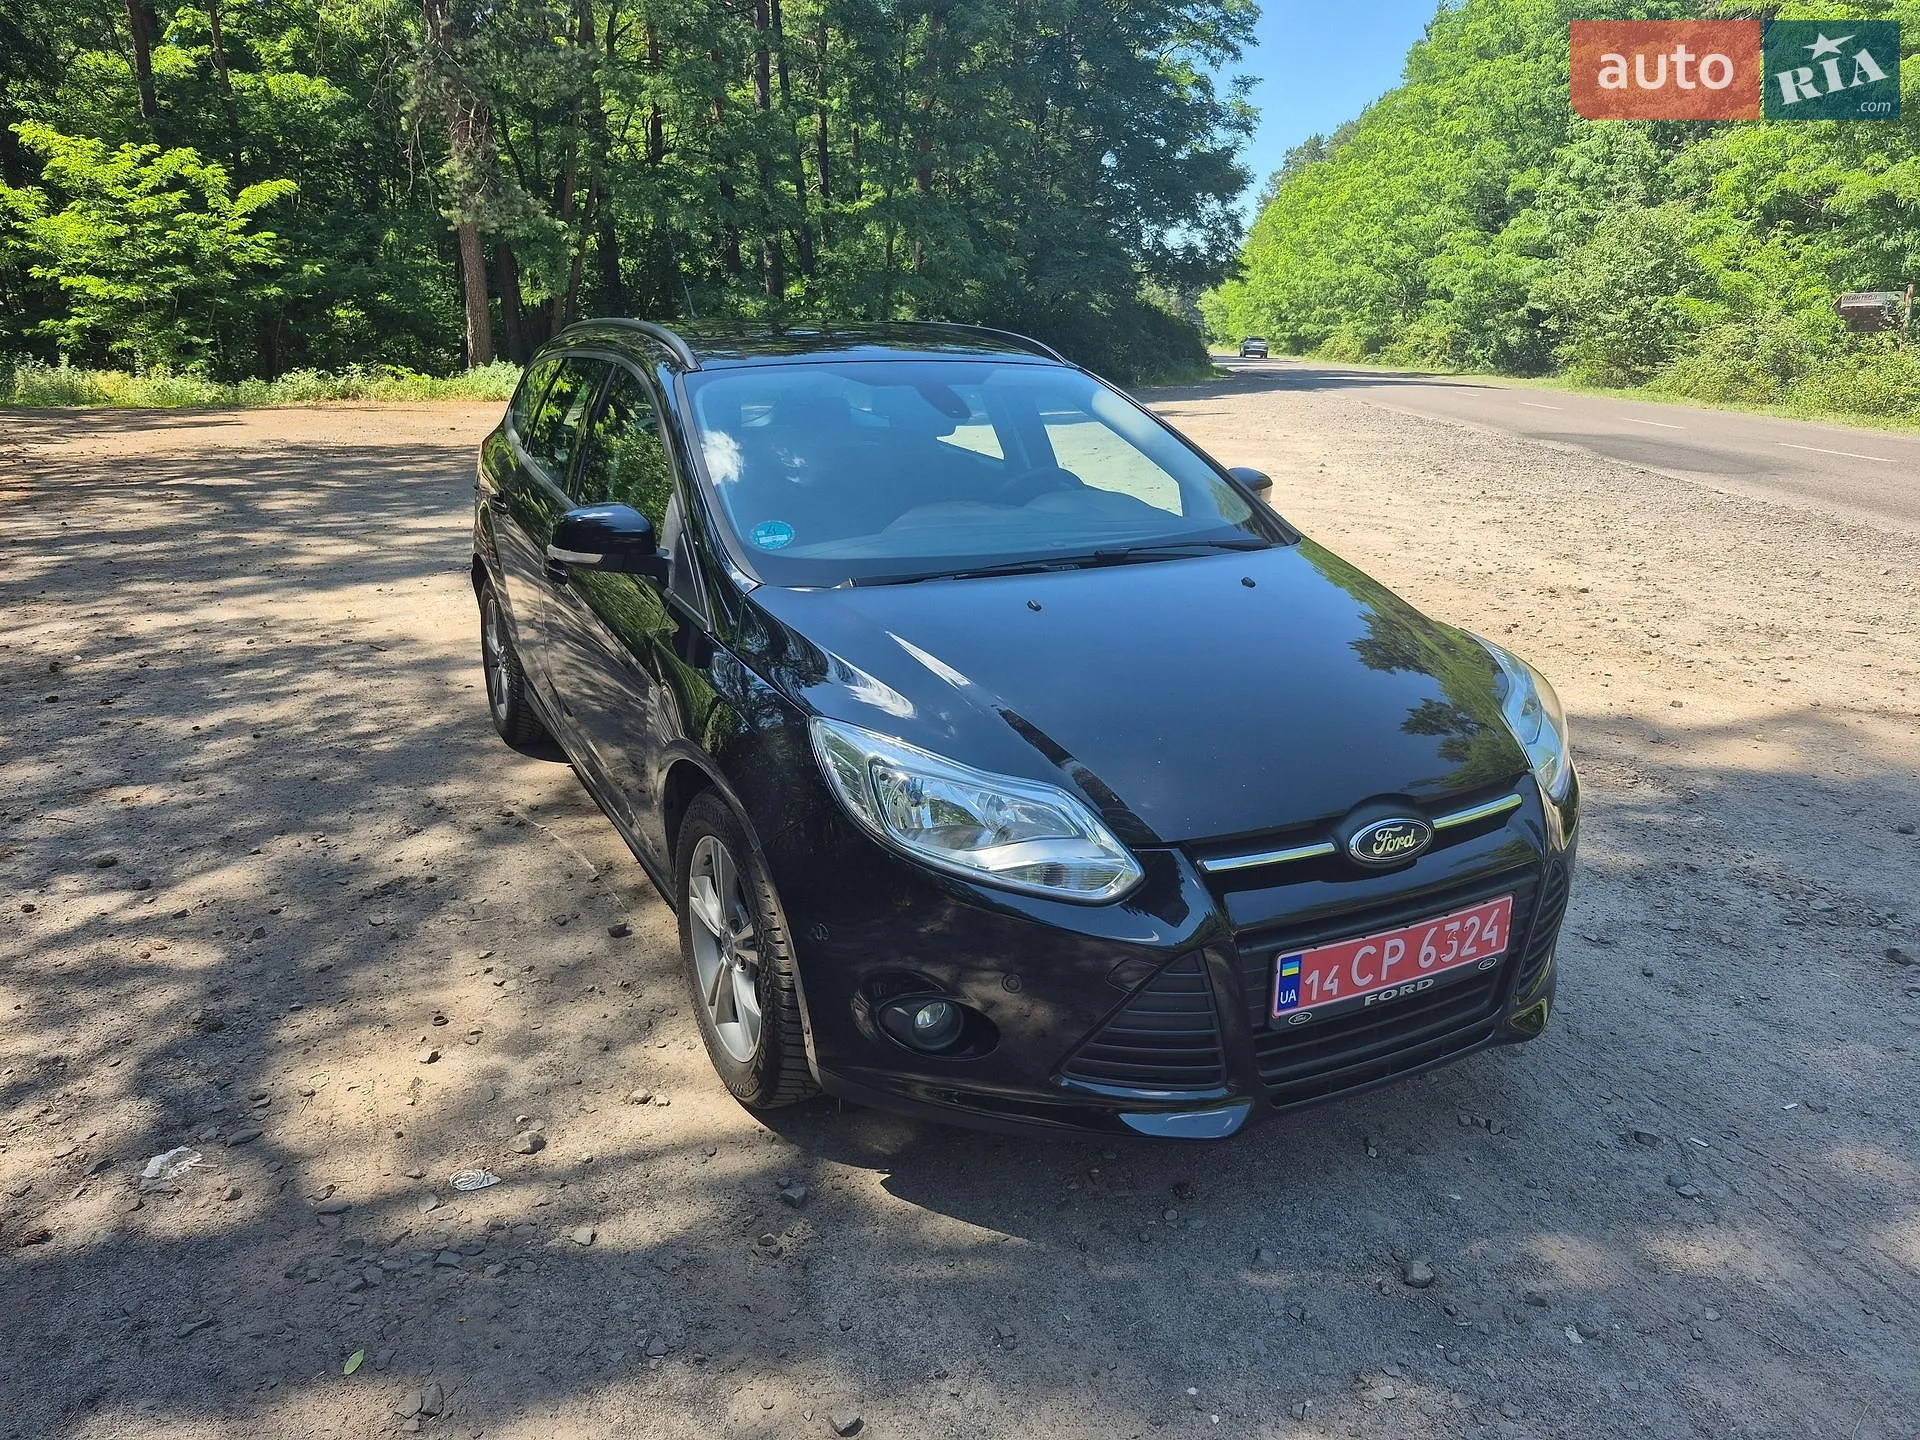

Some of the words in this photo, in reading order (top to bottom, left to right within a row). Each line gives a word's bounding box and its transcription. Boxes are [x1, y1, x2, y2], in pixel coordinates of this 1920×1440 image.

[1372, 825, 1416, 855] Ford
[1304, 965, 1340, 1001] 14
[1351, 938, 1406, 987] CP
[1418, 908, 1500, 971] 6324
[1279, 988, 1297, 1005] UA
[1364, 978, 1435, 1006] FORD
